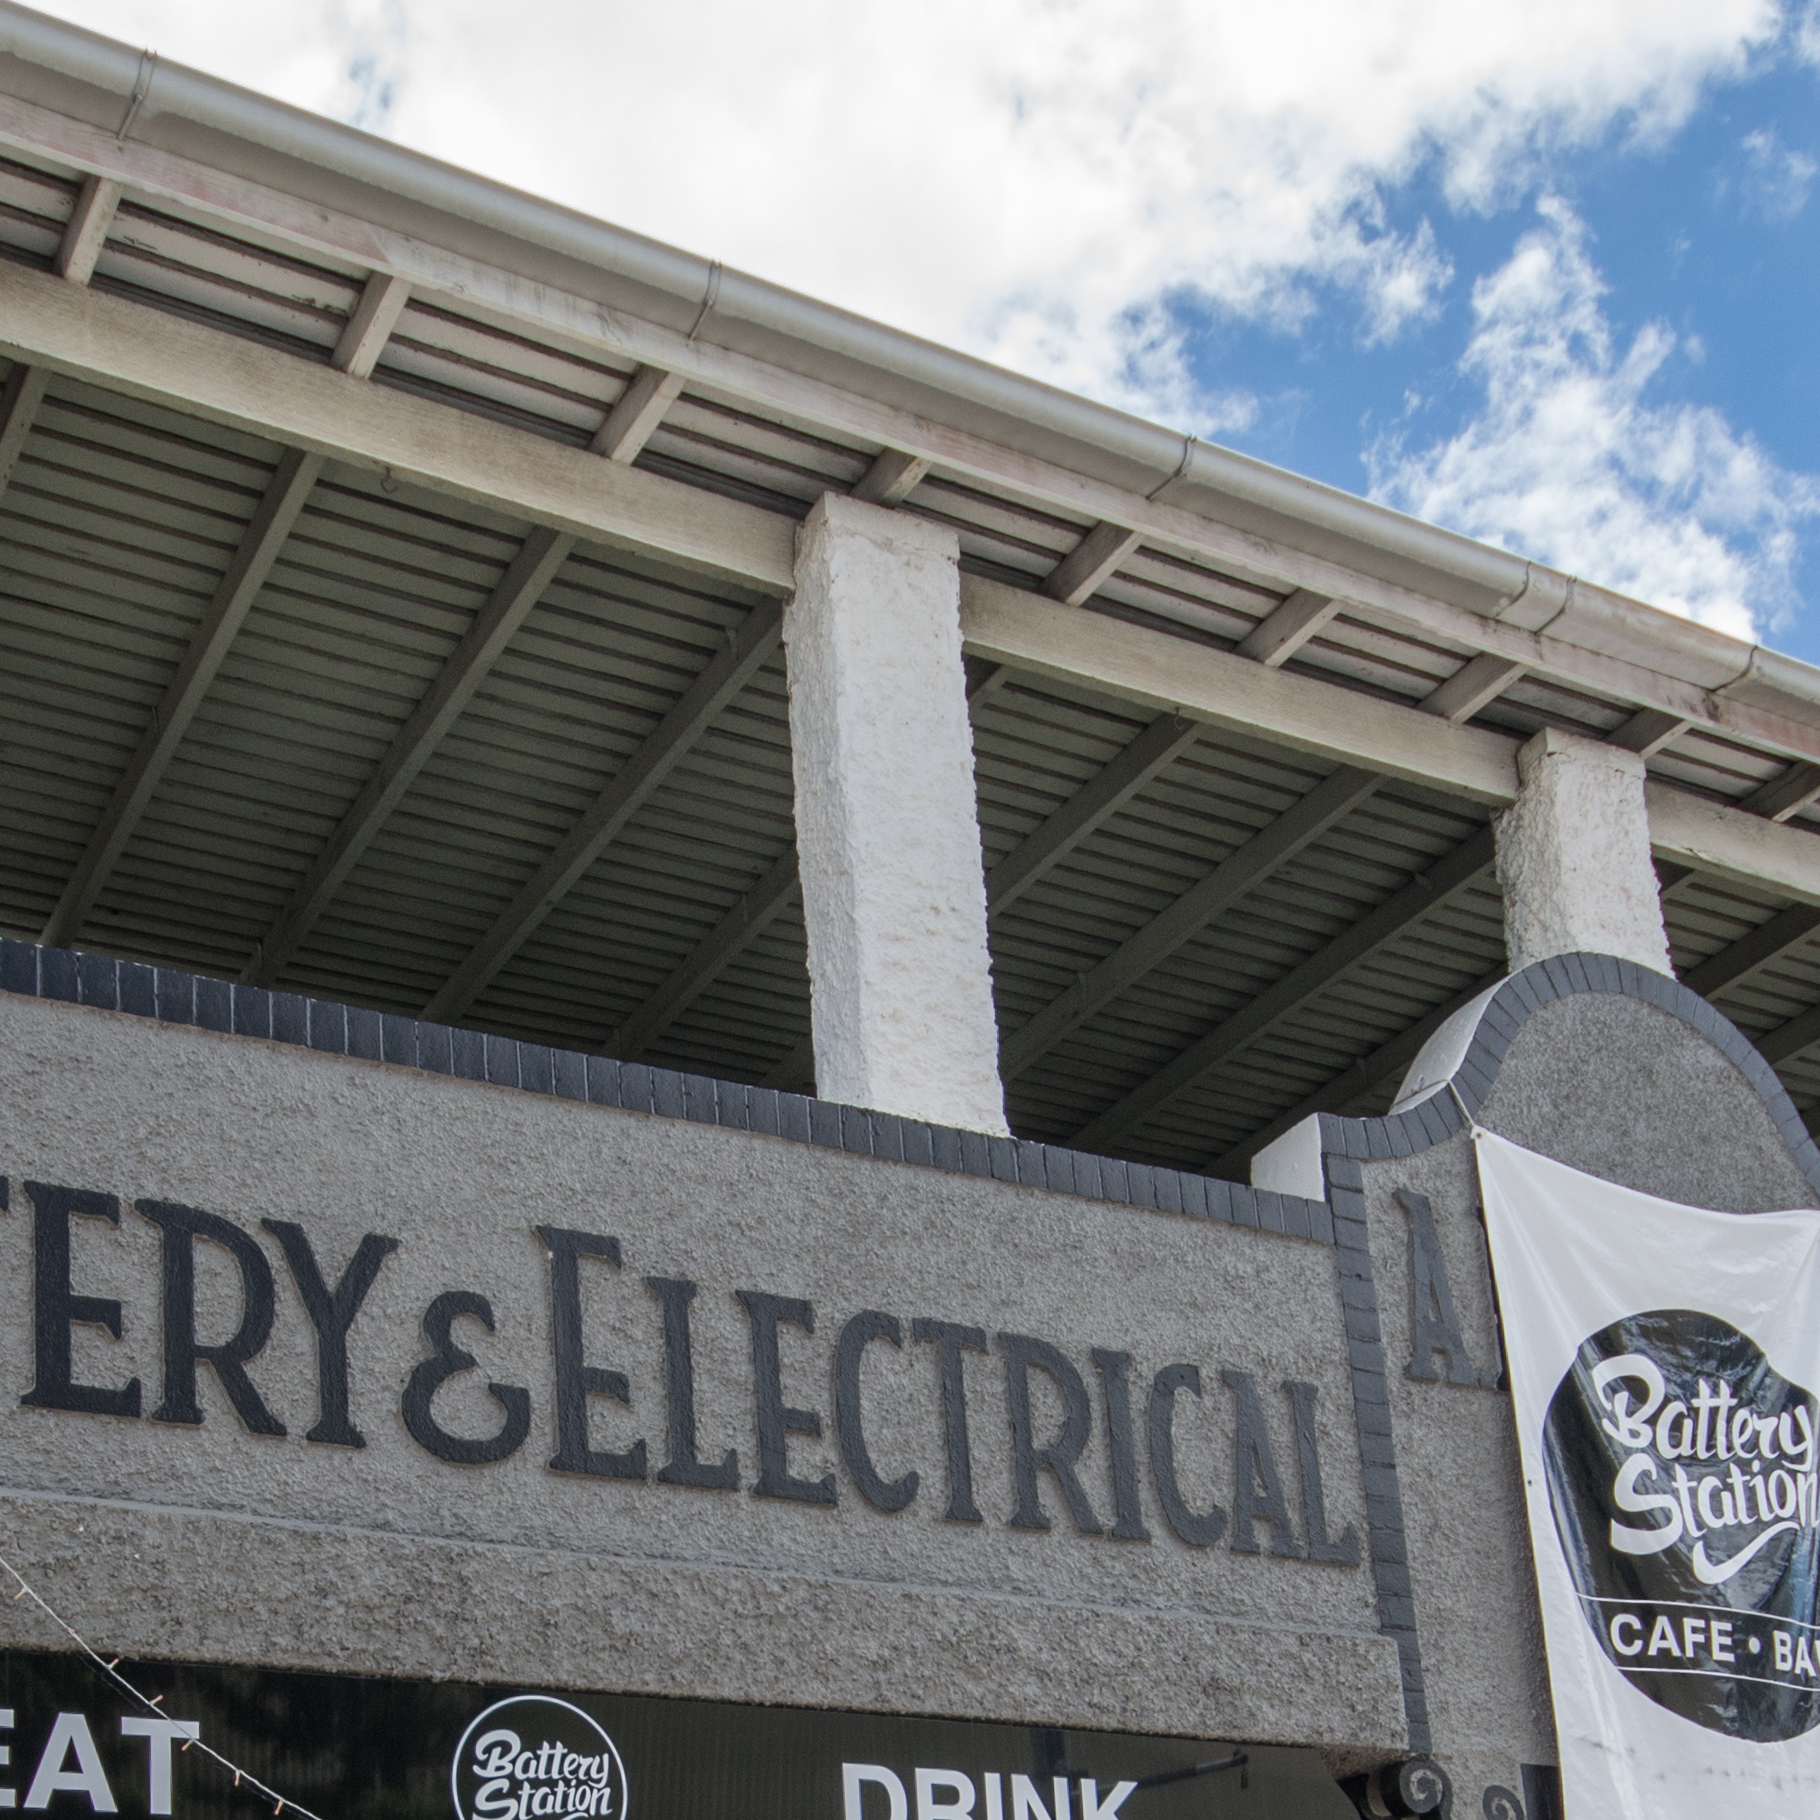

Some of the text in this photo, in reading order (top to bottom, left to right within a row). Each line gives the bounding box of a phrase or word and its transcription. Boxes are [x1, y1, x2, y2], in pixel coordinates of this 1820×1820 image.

[401, 1290, 532, 1465] &
[536, 1225, 1360, 1567] ELECTRICAL
[1592, 1353, 1818, 1470] Battery
[1609, 1612, 1736, 1664] CAFE
[472, 1729, 610, 1785] Battery
